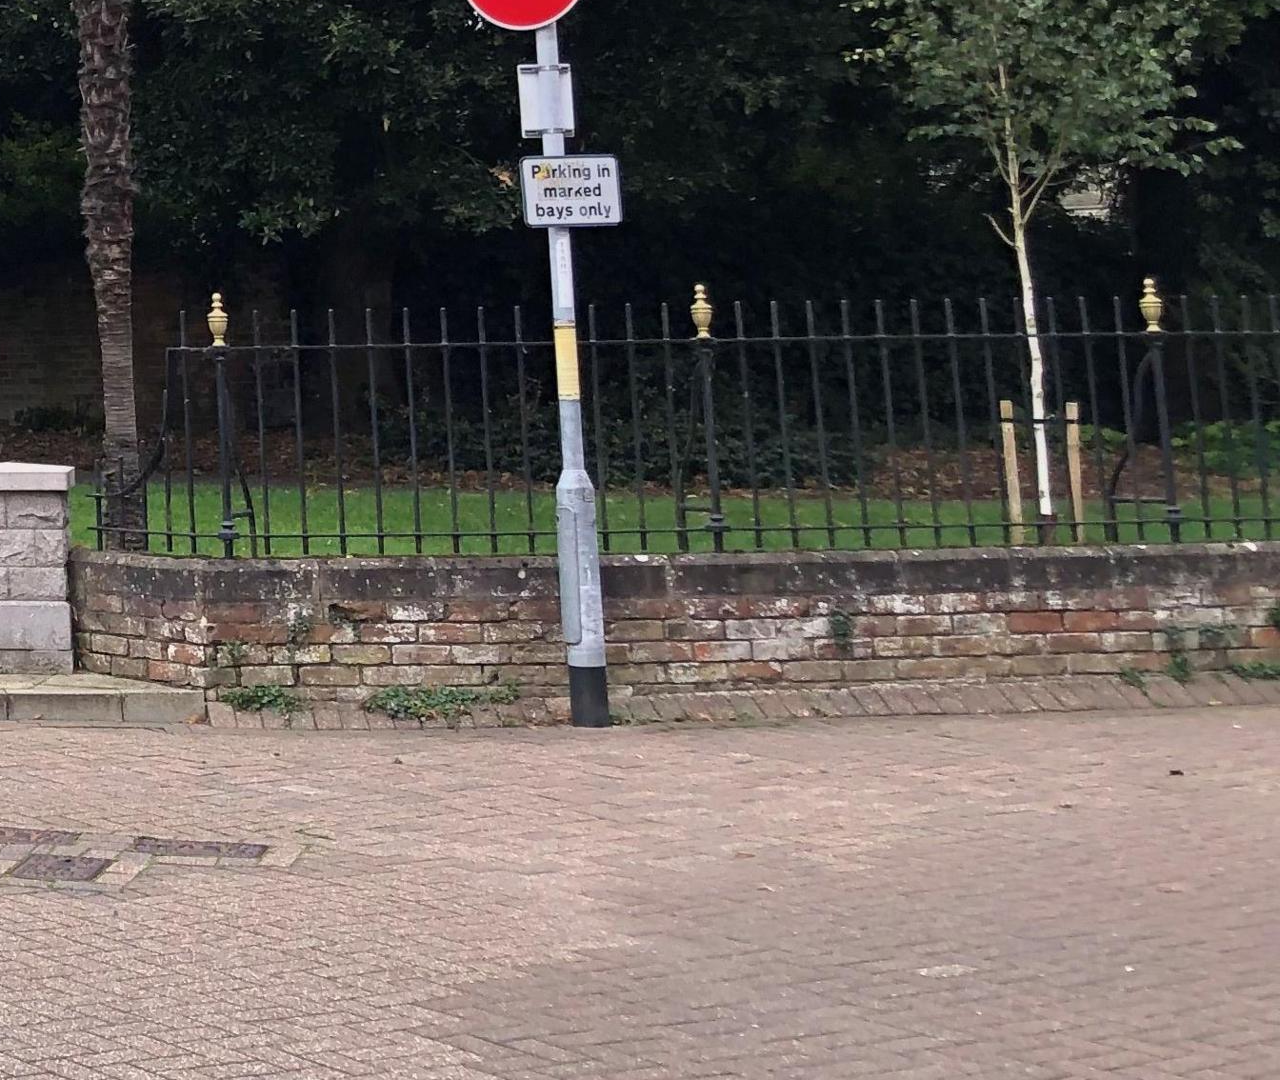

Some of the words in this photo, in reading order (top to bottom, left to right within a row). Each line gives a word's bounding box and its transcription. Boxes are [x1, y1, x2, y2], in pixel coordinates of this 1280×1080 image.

[531, 164, 592, 180] Parking
[597, 163, 610, 178] in
[543, 183, 602, 198] marked
[535, 203, 573, 220] bays
[579, 202, 611, 218] only
